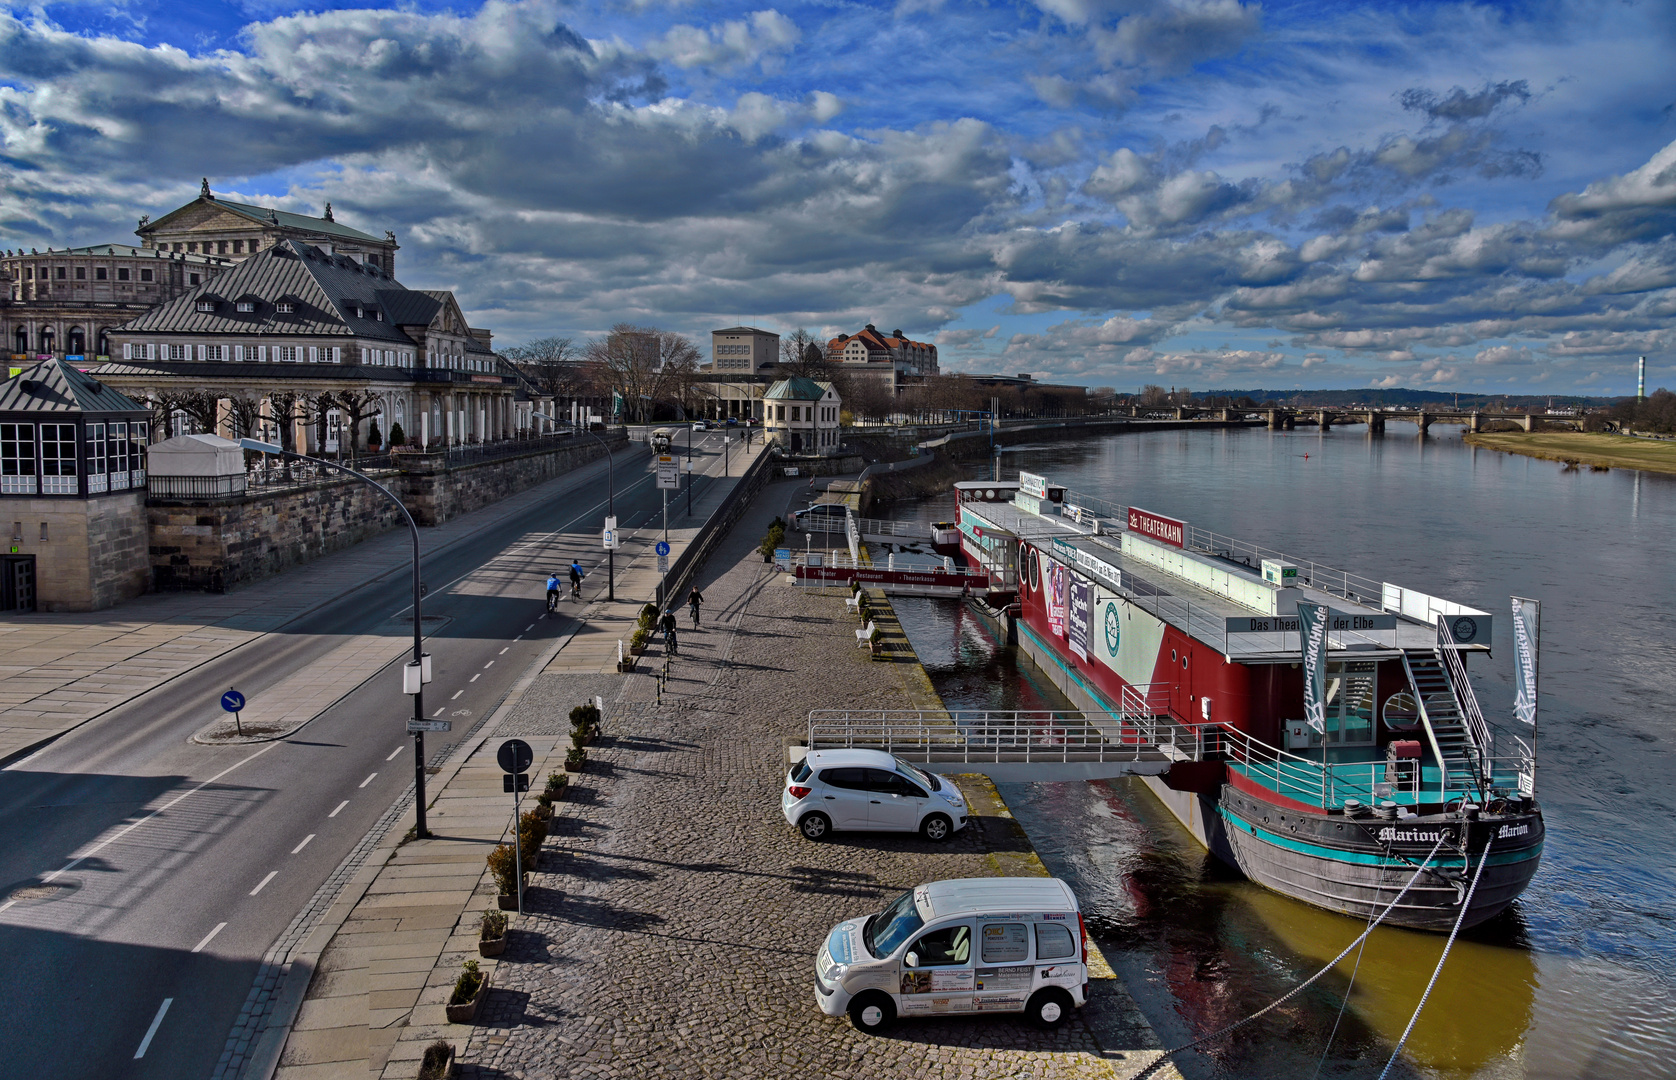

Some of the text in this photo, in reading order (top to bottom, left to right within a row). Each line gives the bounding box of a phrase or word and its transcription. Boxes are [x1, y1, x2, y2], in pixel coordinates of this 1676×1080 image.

[1139, 515, 1181, 543] THEATERKAHN
[856, 572, 884, 580] Restaurant
[903, 574, 936, 582] Theaterkasse
[1250, 618, 1269, 631] Das
[1333, 617, 1350, 630] der
[1354, 617, 1374, 629] Elbe
[1378, 827, 1441, 842] Marion
[1498, 823, 1529, 839] Marion
